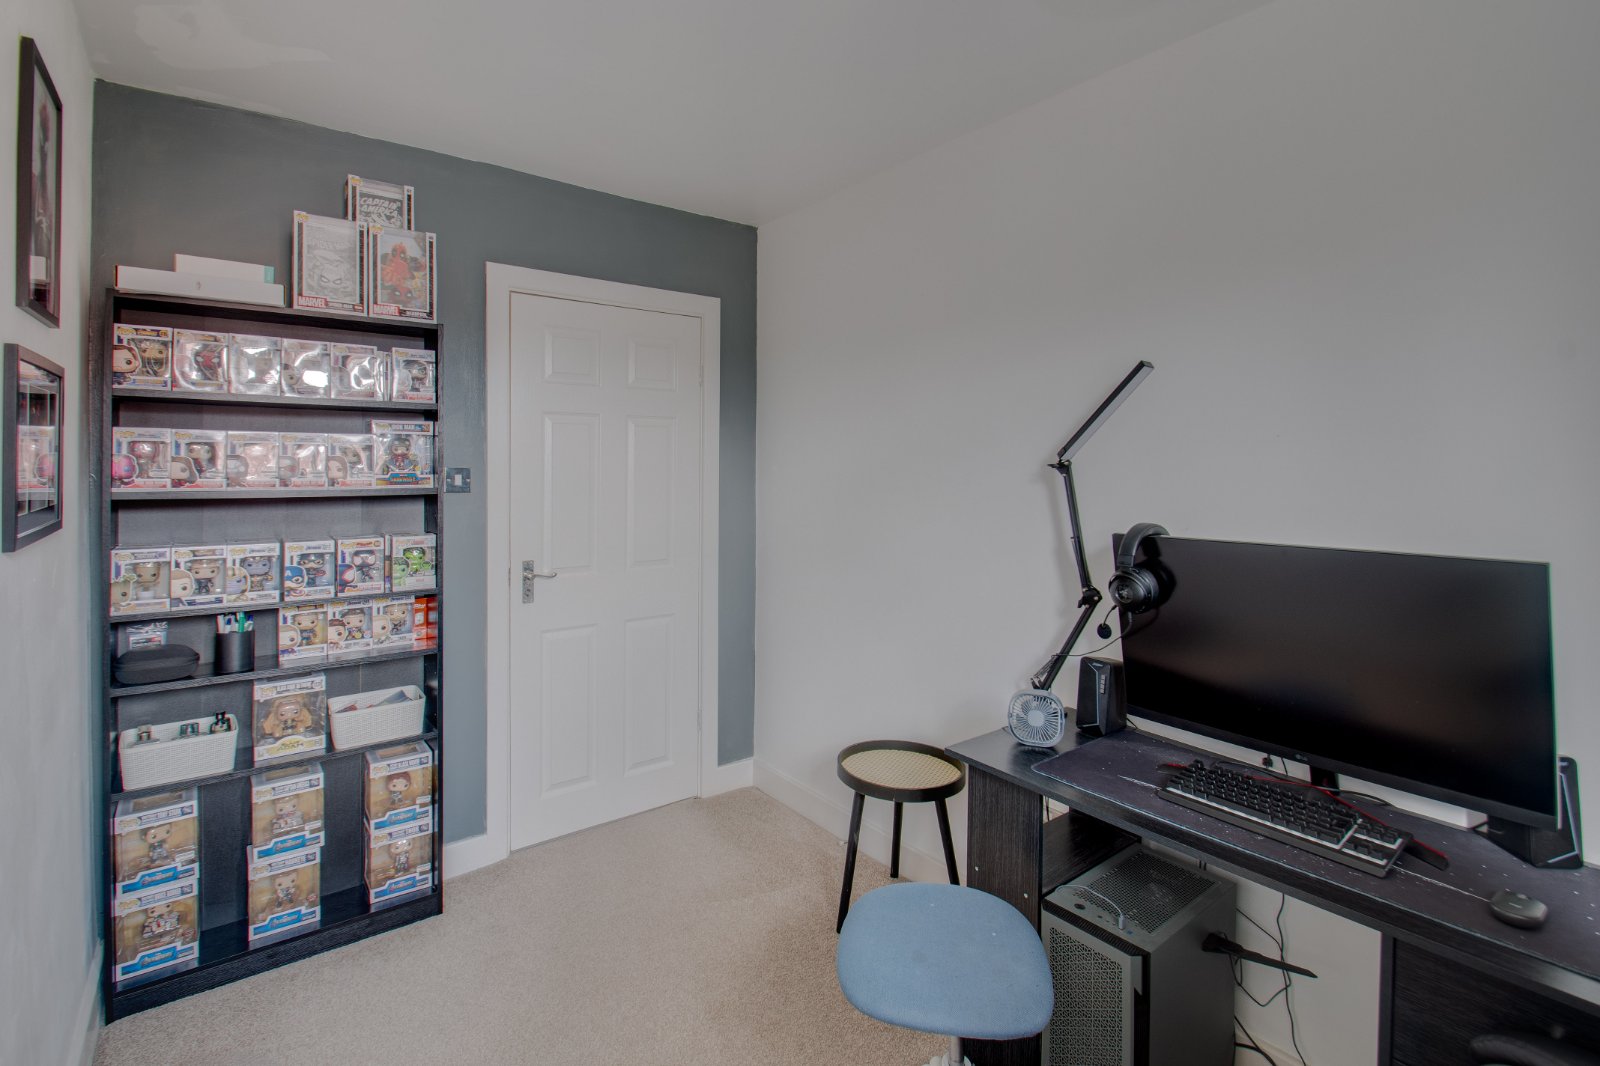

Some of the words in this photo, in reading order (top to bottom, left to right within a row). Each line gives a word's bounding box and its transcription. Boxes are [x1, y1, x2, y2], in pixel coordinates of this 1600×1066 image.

[361, 197, 397, 210] CAPTAIN
[361, 204, 398, 216] AMERICA
[299, 296, 326, 308] MARVEL
[374, 304, 399, 316] MARVEL
